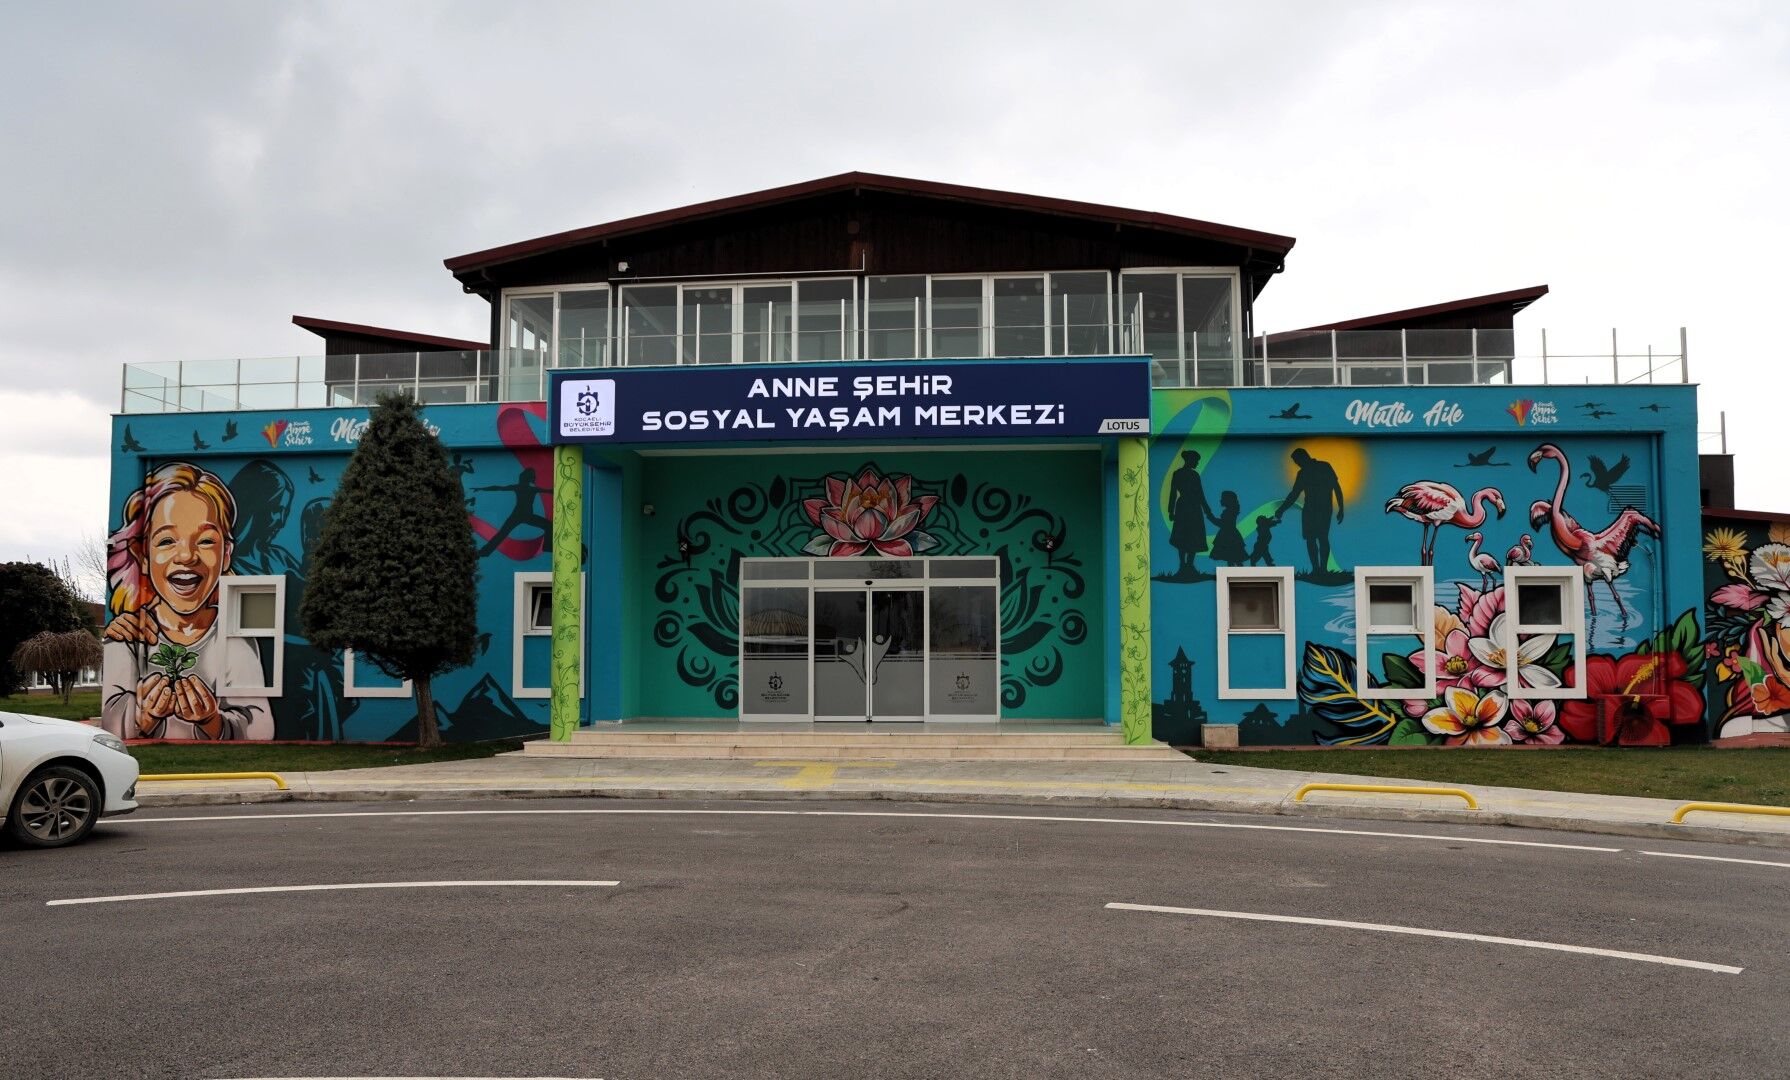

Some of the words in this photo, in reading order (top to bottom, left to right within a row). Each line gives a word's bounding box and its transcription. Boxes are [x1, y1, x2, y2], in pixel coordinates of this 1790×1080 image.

[748, 376, 839, 399] ANNE
[643, 408, 776, 431] SOSYAL
[786, 406, 901, 433] YAŞAM
[1107, 421, 1140, 431] LOTUS
[1345, 400, 1414, 428] Mutlu
[1423, 400, 1464, 427] Aile
